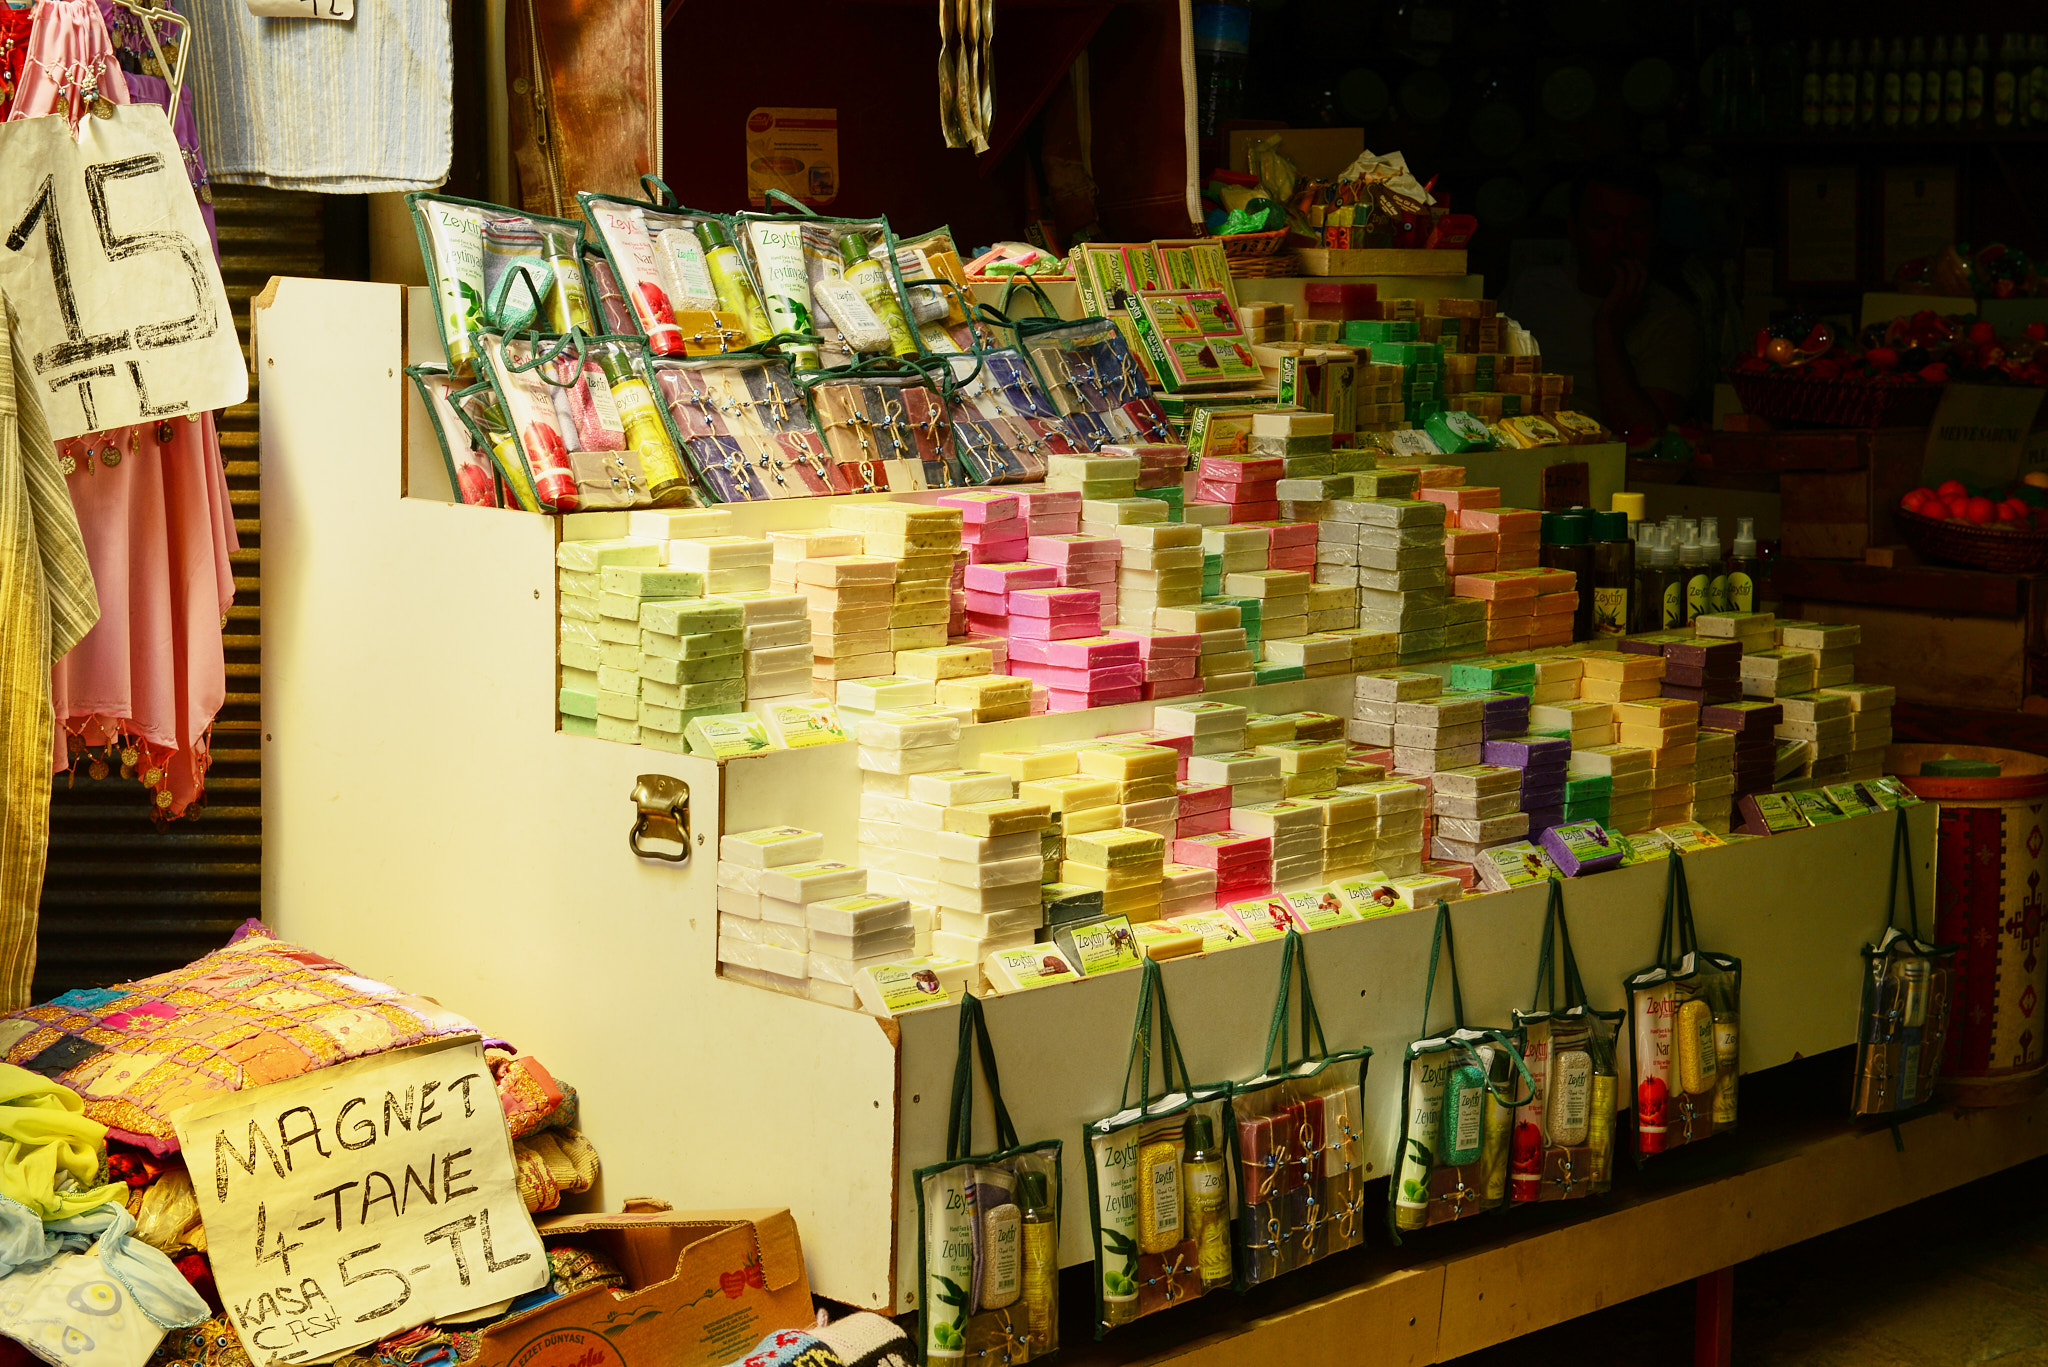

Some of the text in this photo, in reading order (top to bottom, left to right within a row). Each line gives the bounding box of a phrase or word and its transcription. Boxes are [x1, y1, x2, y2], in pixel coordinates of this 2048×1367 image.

[5, 151, 218, 376] 15
[1127, 294, 1142, 319] Zeytin
[49, 359, 189, 431] TL
[616, 389, 640, 409] eytin
[1667, 594, 1680, 606] Zey
[1346, 885, 1374, 900] Zeytin
[1076, 931, 1104, 950] Zeytin
[1005, 954, 1036, 969] Zeytin
[1656, 1042, 1670, 1057] Nar
[1567, 1072, 1587, 1087] Zeytin
[1461, 1091, 1480, 1108] Zeytin
[215, 1073, 480, 1203] MAGNET
[1155, 1166, 1175, 1185] Zeytin
[1205, 1174, 1222, 1189] Zey
[946, 1188, 968, 1216] Zey
[998, 1224, 1017, 1244] Zeytin
[234, 1278, 329, 1331] KASA
[514, 1332, 585, 1367] EZZET DÜNYASI
